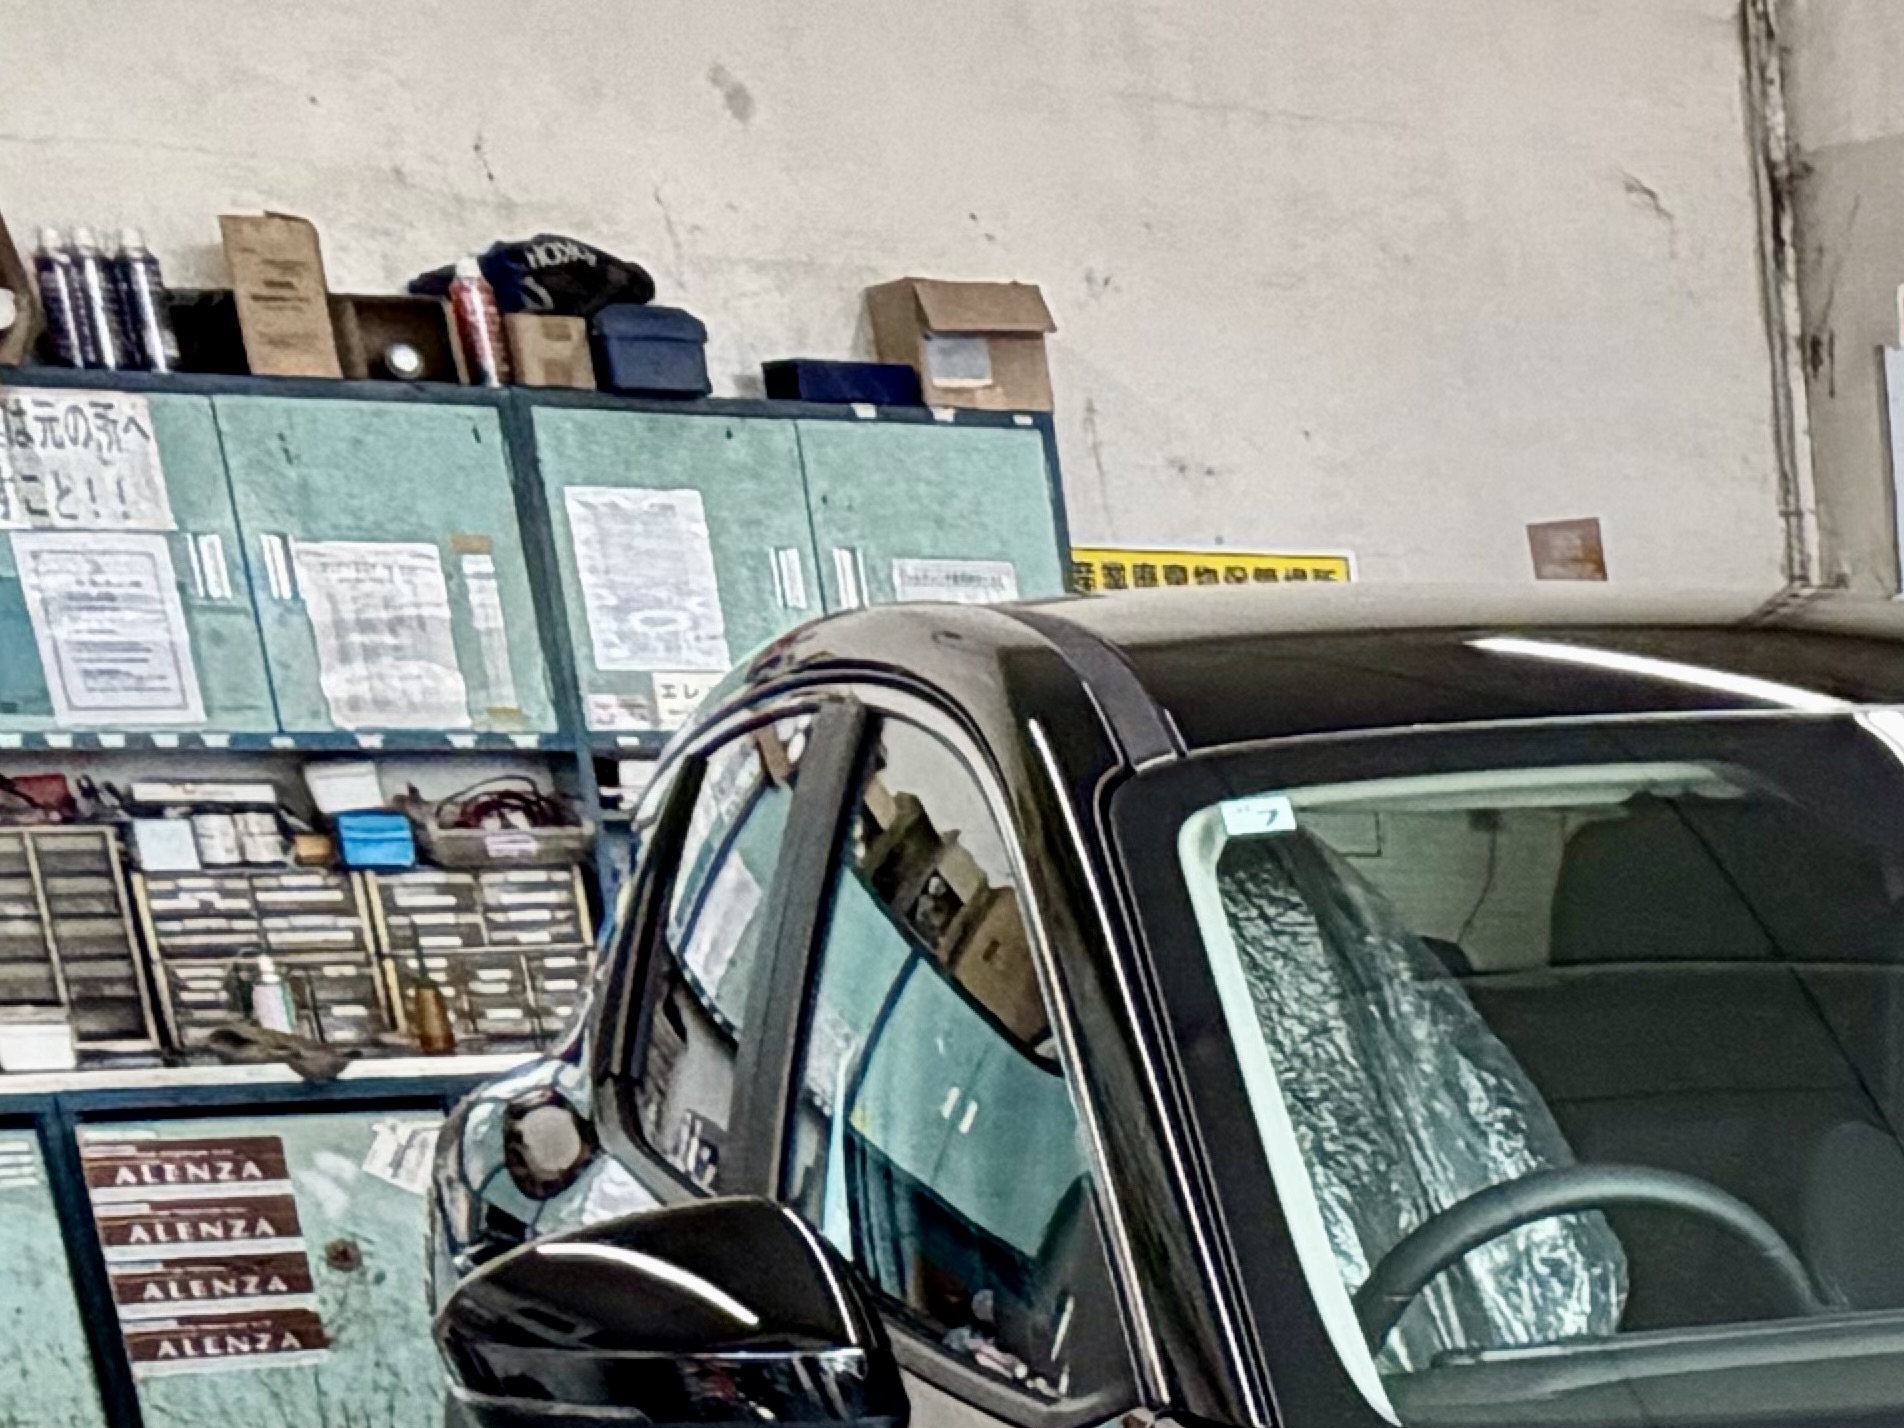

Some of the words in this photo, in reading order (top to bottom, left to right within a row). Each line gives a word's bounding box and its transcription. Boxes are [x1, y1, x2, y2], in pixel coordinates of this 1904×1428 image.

[115, 1160, 263, 1185] ALENZA
[130, 1216, 276, 1243] ALENZA
[143, 1275, 288, 1301] ALENZA
[157, 1330, 301, 1358] ALENZA
